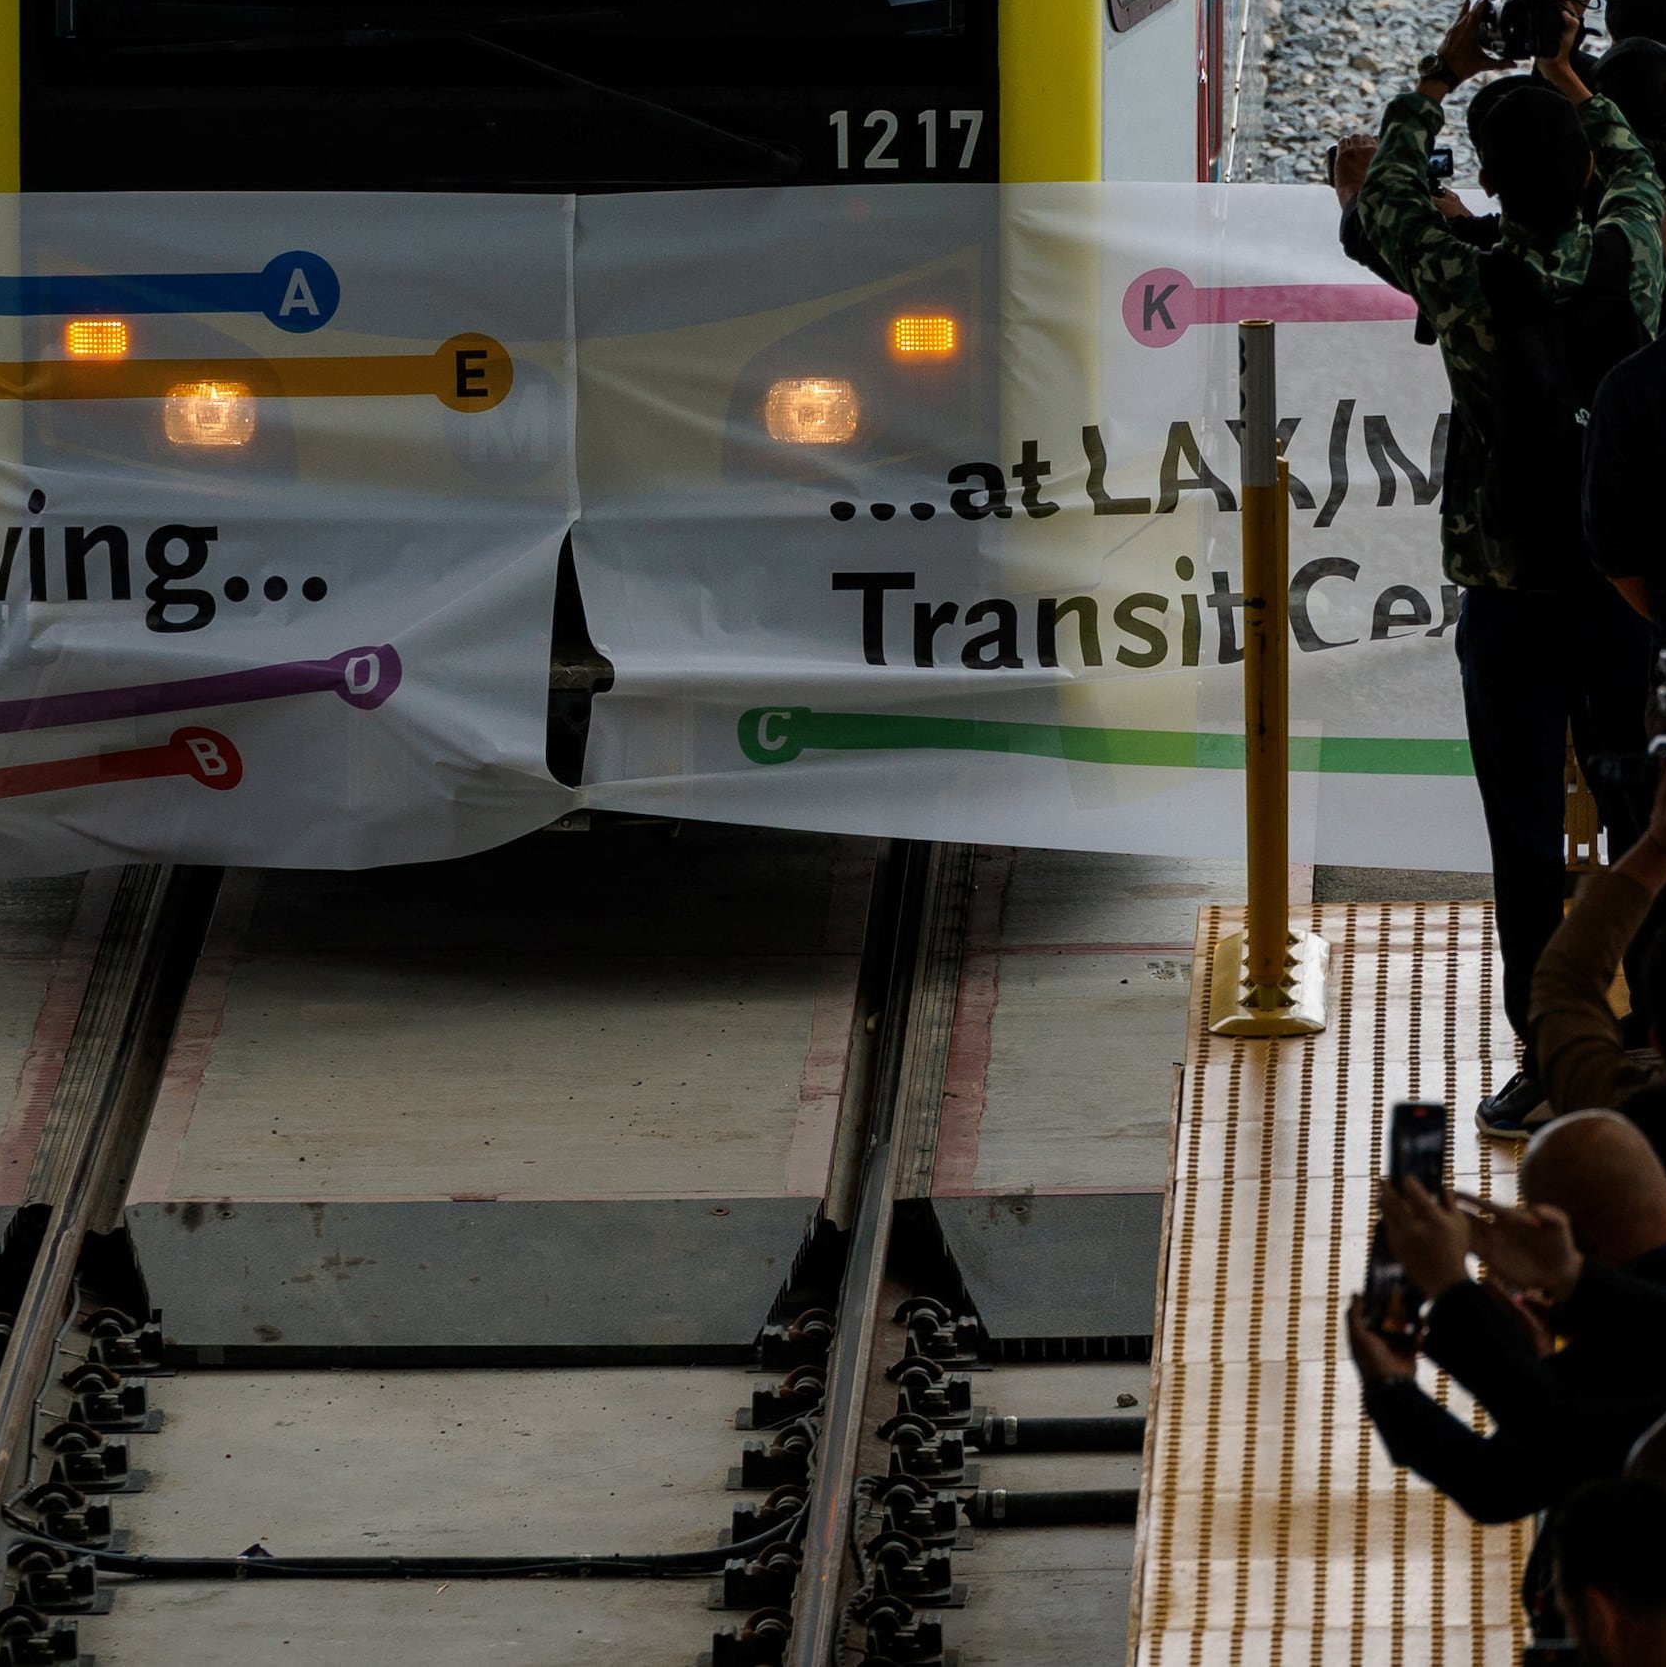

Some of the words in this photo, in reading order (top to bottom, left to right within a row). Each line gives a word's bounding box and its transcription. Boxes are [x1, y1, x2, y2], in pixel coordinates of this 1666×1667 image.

[828, 108, 984, 170] 1217
[278, 268, 320, 315] A
[1143, 284, 1180, 332] K
[456, 349, 488, 398] E
[830, 440, 1060, 522] ...at
[831, 555, 1245, 670] Transit
[758, 710, 792, 751] C
[187, 736, 225, 778] B
